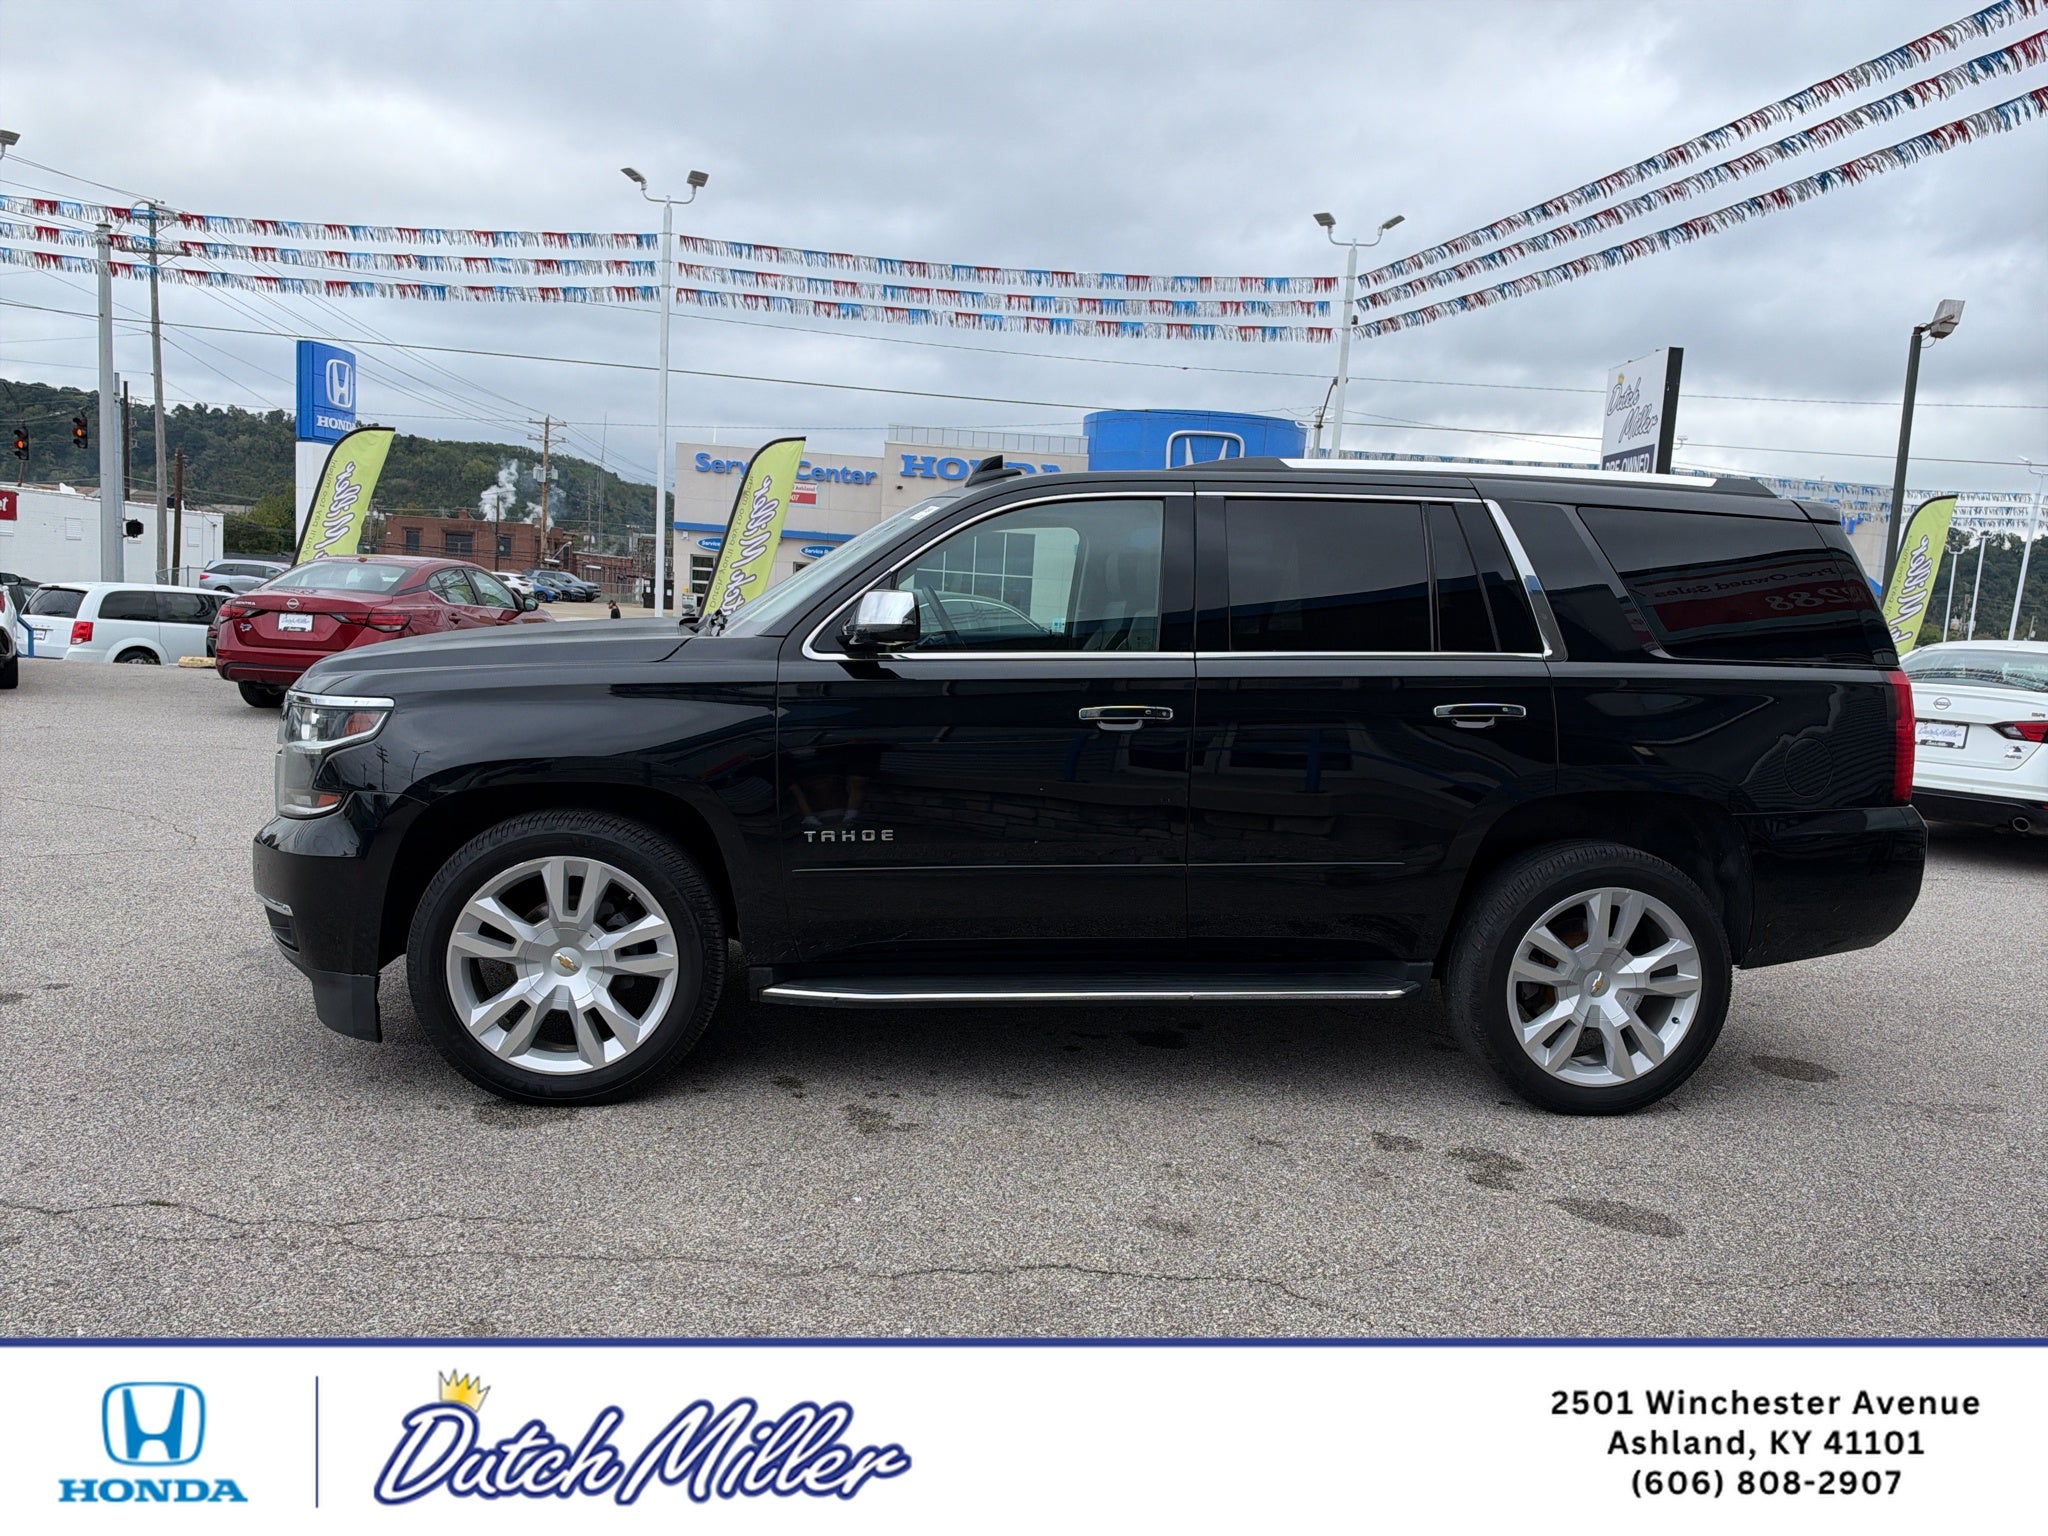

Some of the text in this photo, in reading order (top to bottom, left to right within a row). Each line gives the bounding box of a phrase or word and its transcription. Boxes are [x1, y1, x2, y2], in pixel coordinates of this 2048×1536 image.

[1607, 377, 1641, 416] Dutch
[1618, 403, 1658, 443] Miller
[695, 452, 877, 485] Serv Center
[803, 829, 894, 843] TAHOE
